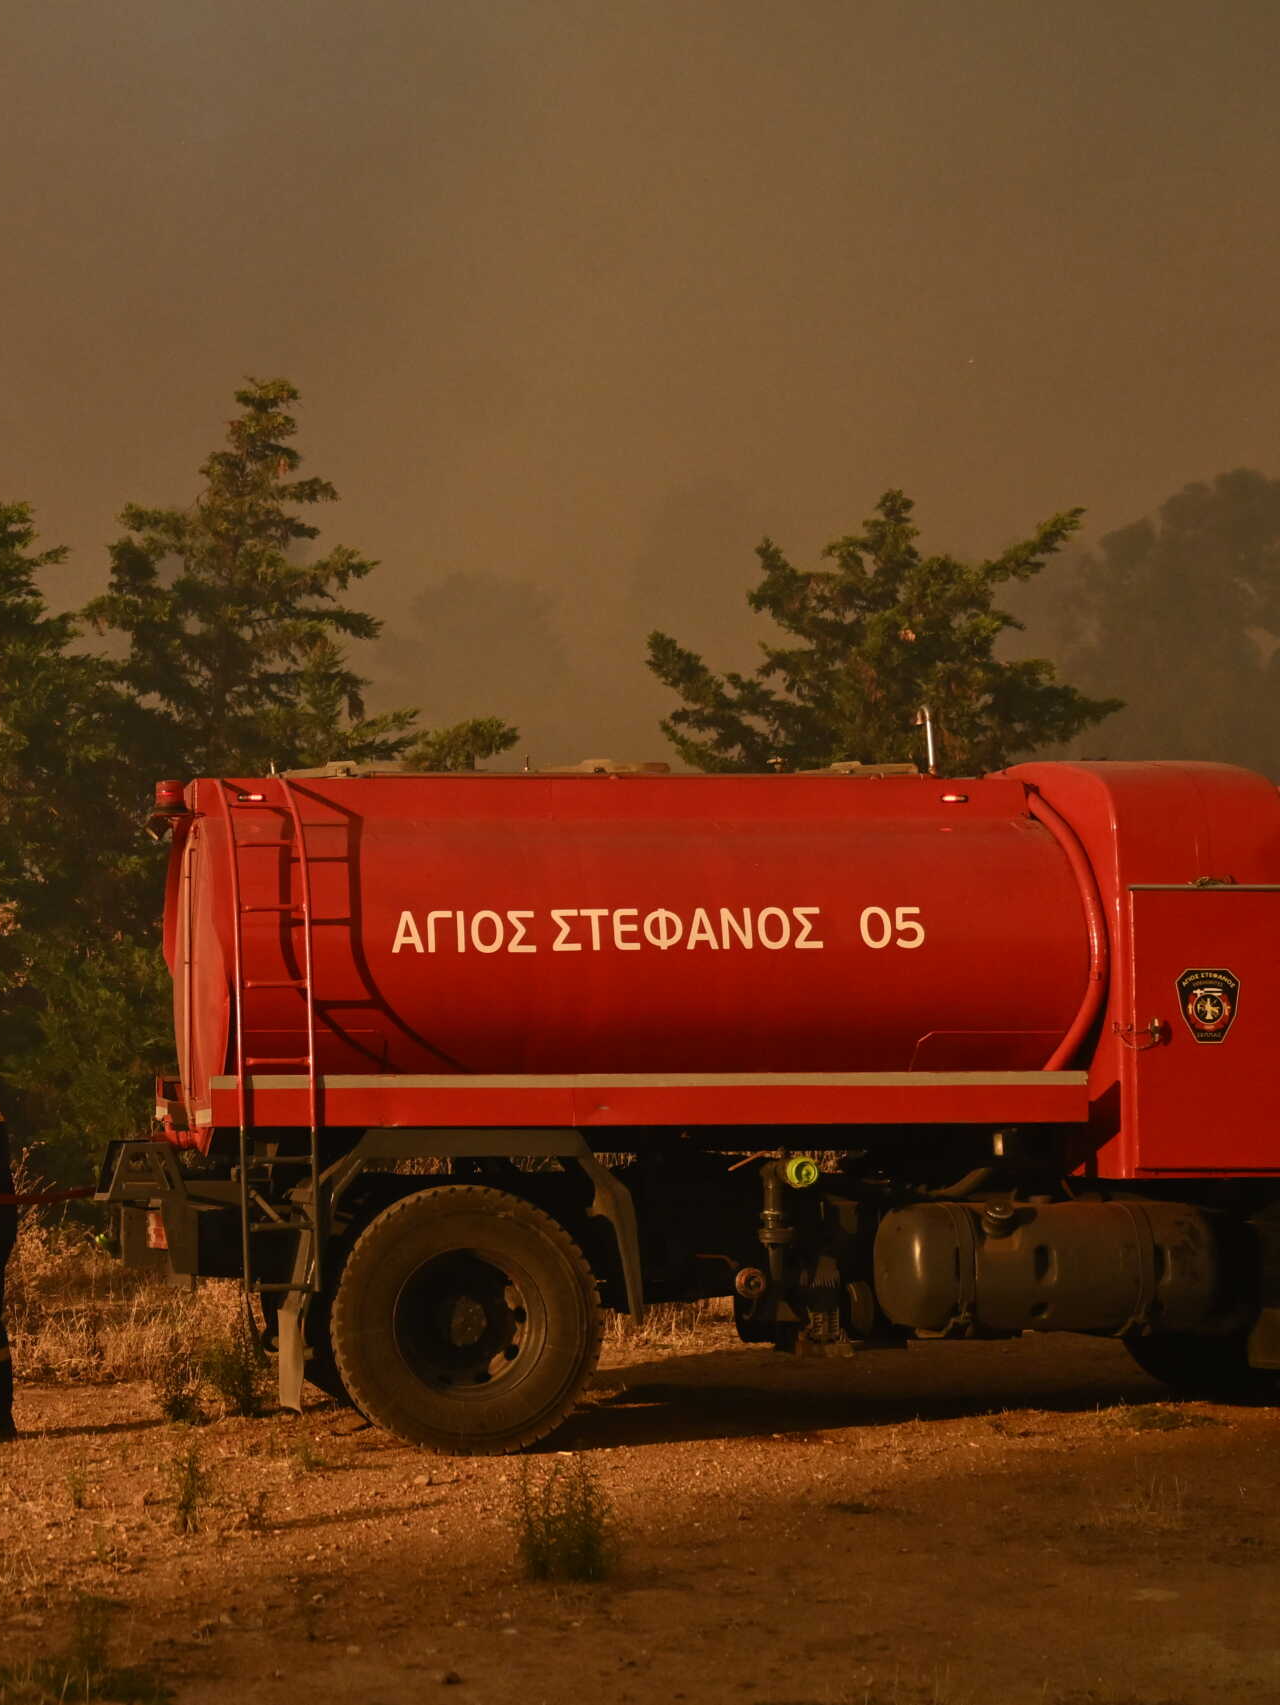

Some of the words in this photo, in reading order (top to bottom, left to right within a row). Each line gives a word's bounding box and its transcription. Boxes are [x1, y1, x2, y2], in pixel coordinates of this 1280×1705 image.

[391, 910, 537, 954] ΑΓΙΟΣ
[550, 907, 824, 952] ΣΤΕΦΑΝΟΣ
[859, 906, 926, 950] 05
